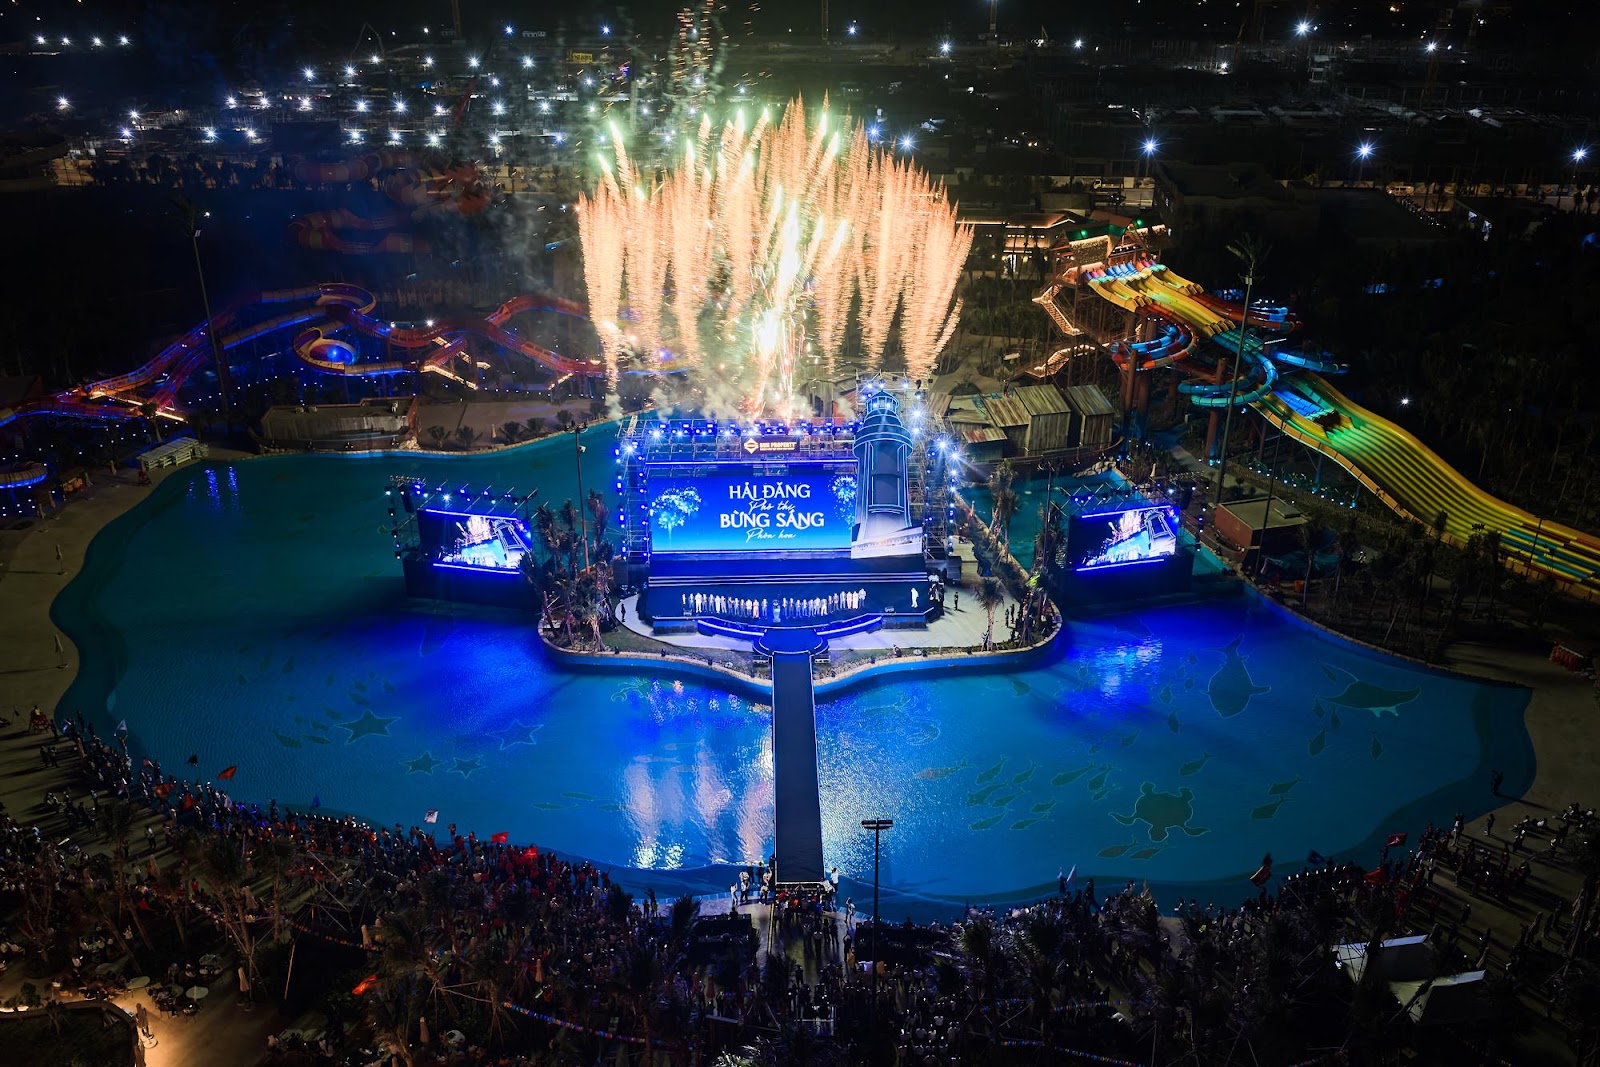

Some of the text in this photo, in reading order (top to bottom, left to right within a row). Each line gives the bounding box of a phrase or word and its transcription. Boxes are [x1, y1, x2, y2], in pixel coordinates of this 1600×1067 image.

[729, 481, 811, 500] HẢI ĐĂNG
[720, 509, 825, 530] BỪNG SÁNG
